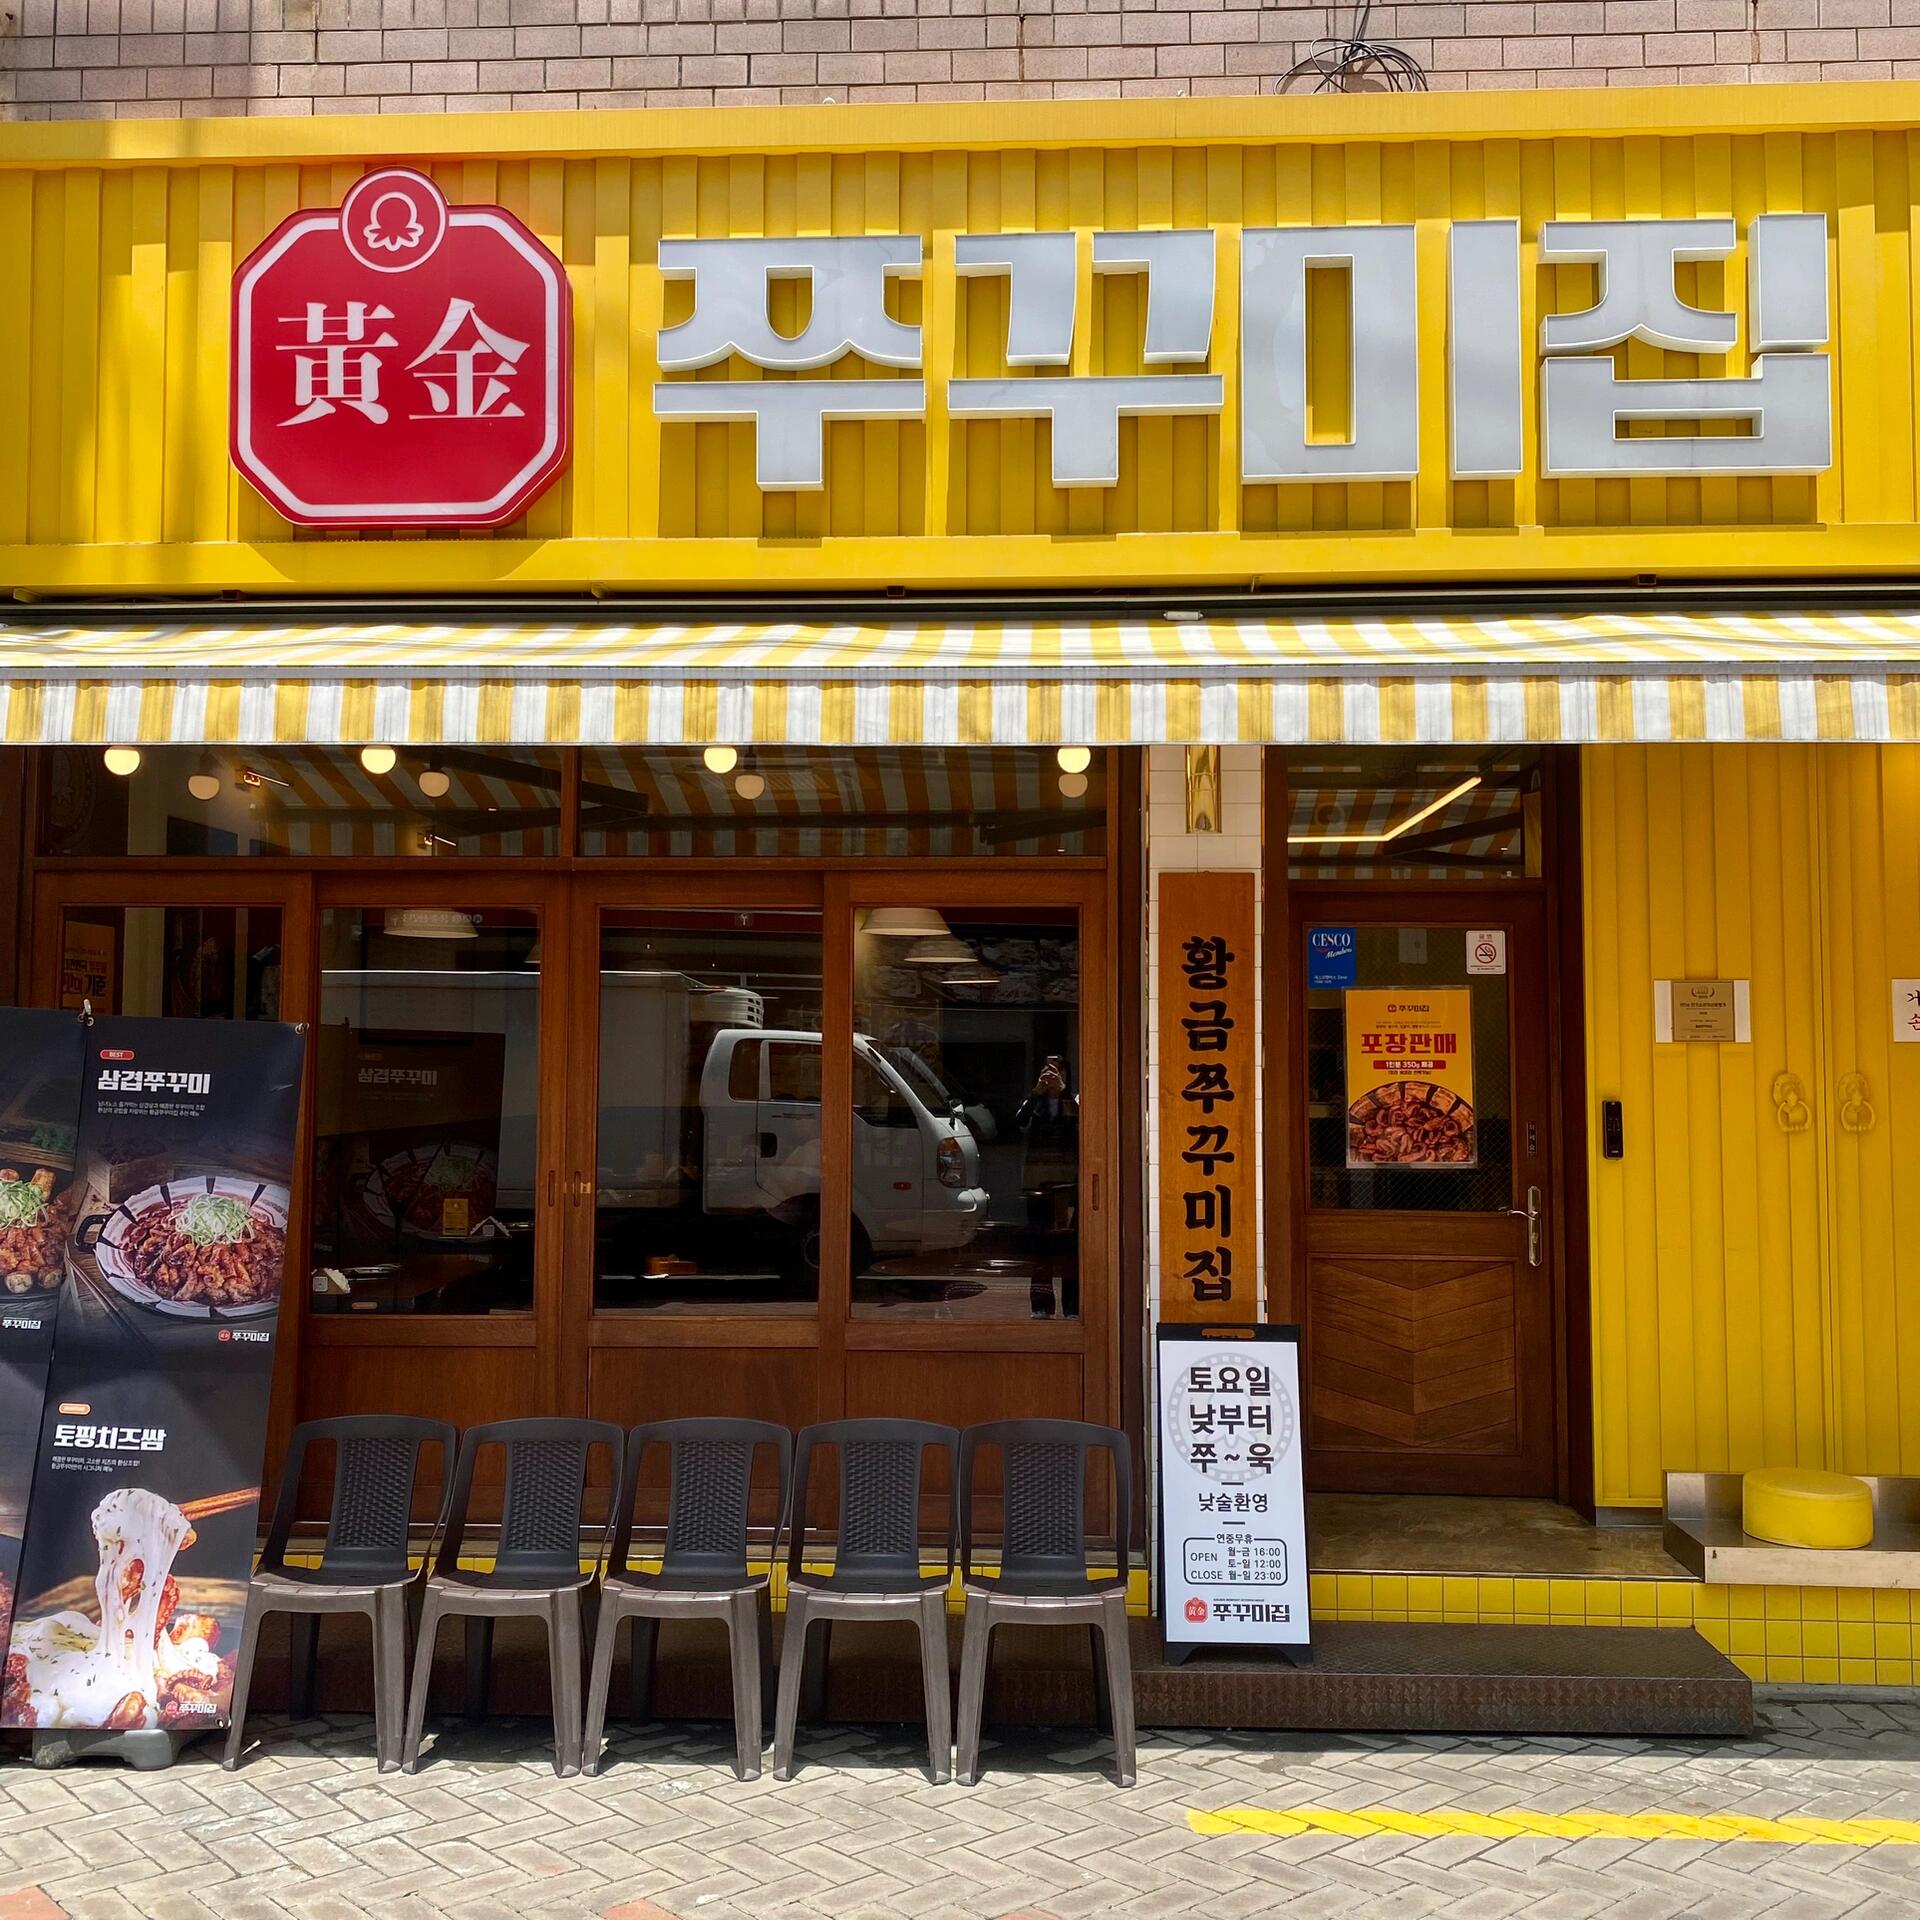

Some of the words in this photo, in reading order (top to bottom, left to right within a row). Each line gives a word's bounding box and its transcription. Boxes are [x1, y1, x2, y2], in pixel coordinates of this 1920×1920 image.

[653, 213, 1833, 492] 쭈꾸미집
[1312, 932, 1351, 947] CESCO
[1361, 1033, 1457, 1054] 포장판매
[1402, 1061, 1420, 1069] 350g
[98, 1070, 211, 1094] 삼겹쭈꾸미
[1181, 935, 1235, 1302] 황금쭈꾸미집
[1188, 1366, 1271, 1396] 토요일
[1190, 1404, 1272, 1435] 낮부터
[53, 1424, 167, 1451] 토핑치즈쌈
[1198, 1493, 1268, 1513] 낮술환영
[1216, 1533, 1253, 1544] 연중무휴
[1190, 1552, 1218, 1562] OPEN
[1254, 1547, 1281, 1557] 16:00
[1254, 1559, 1281, 1569] 12:00
[1190, 1570, 1223, 1580] CLOSE
[1254, 1571, 1282, 1581] 23:00
[1213, 1604, 1290, 1622] 쭈꾸미집
